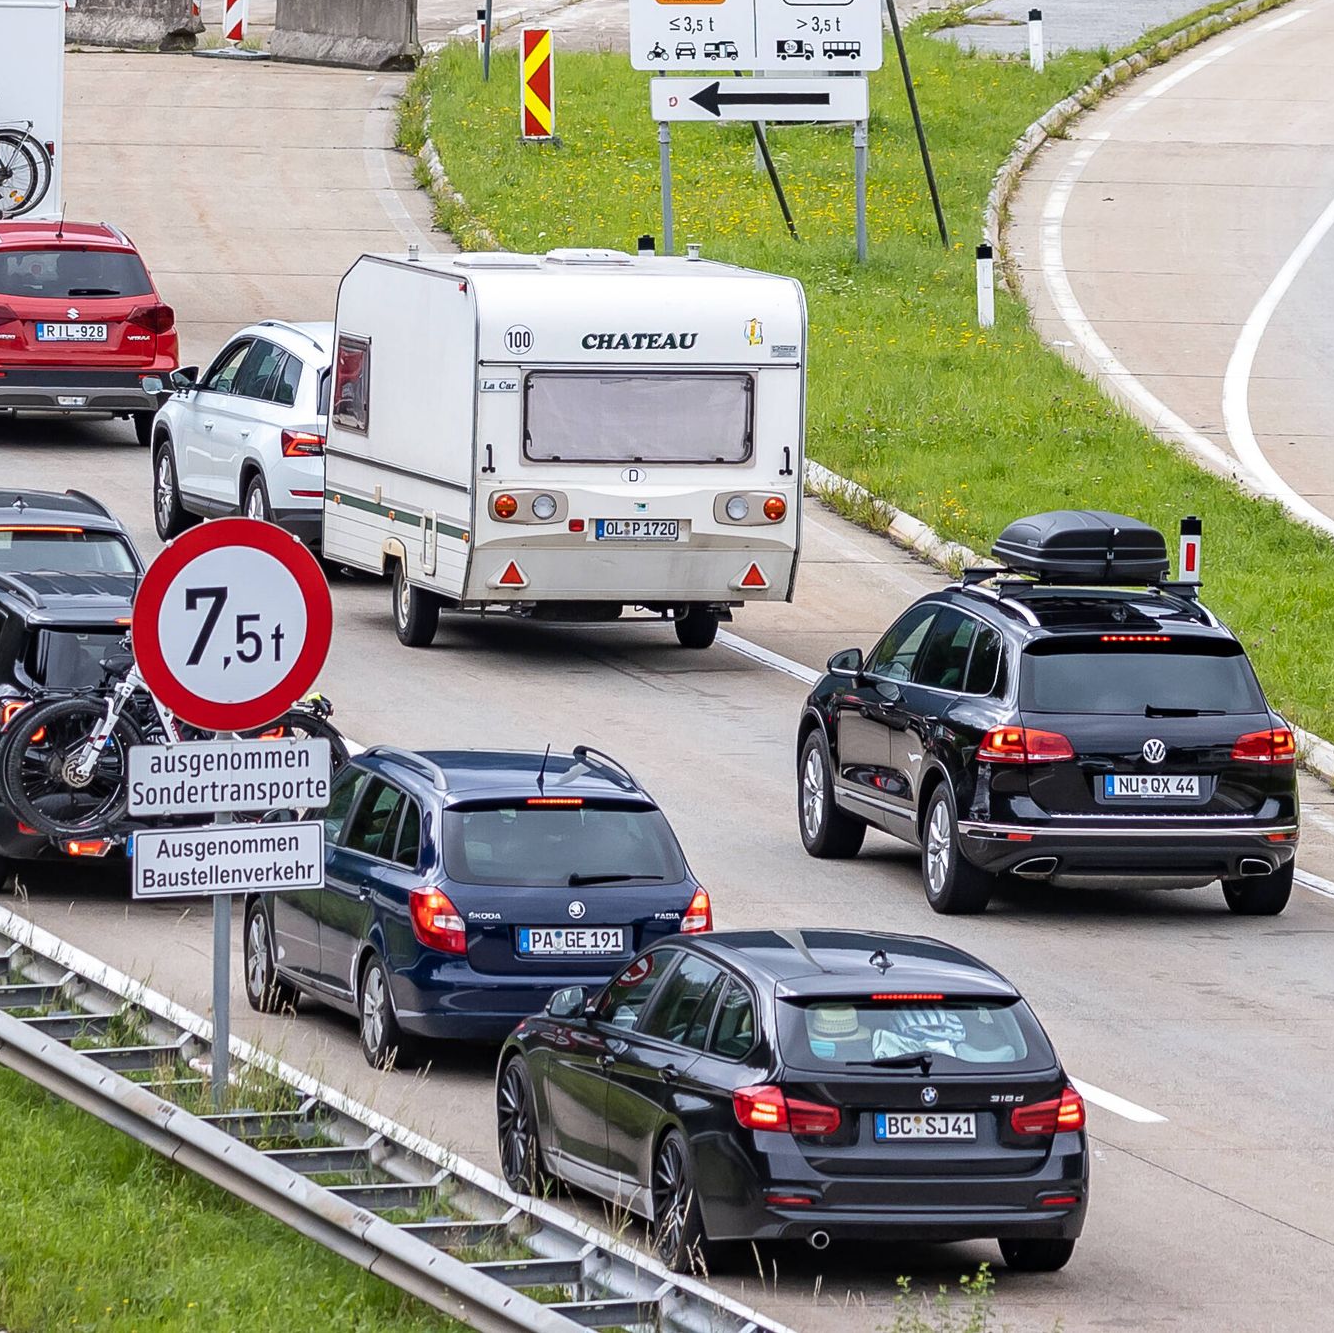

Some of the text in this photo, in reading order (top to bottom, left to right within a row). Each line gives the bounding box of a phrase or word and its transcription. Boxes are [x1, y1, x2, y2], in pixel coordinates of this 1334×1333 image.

[46, 324, 104, 338] RIL-928
[507, 331, 531, 349] 100
[581, 332, 699, 350] CHATEAU
[482, 381, 517, 391] La Car
[628, 469, 639, 483] D
[605, 521, 677, 537] OL P 1720
[150, 748, 311, 778] ausgenommen
[131, 777, 327, 806] Sondertransporte
[1119, 777, 1139, 793] NU
[1151, 778, 1171, 793] QX
[1175, 777, 1195, 793] 44
[155, 835, 300, 862] Ausgenommen
[142, 860, 315, 889] Baustellenverkehr
[468, 911, 502, 920] ŠKODA
[531, 932, 554, 949] PA
[565, 932, 587, 948] GE
[590, 931, 622, 949] 191
[888, 1117, 913, 1135] BC
[925, 1116, 949, 1135] SJ
[952, 1117, 974, 1135] 41
